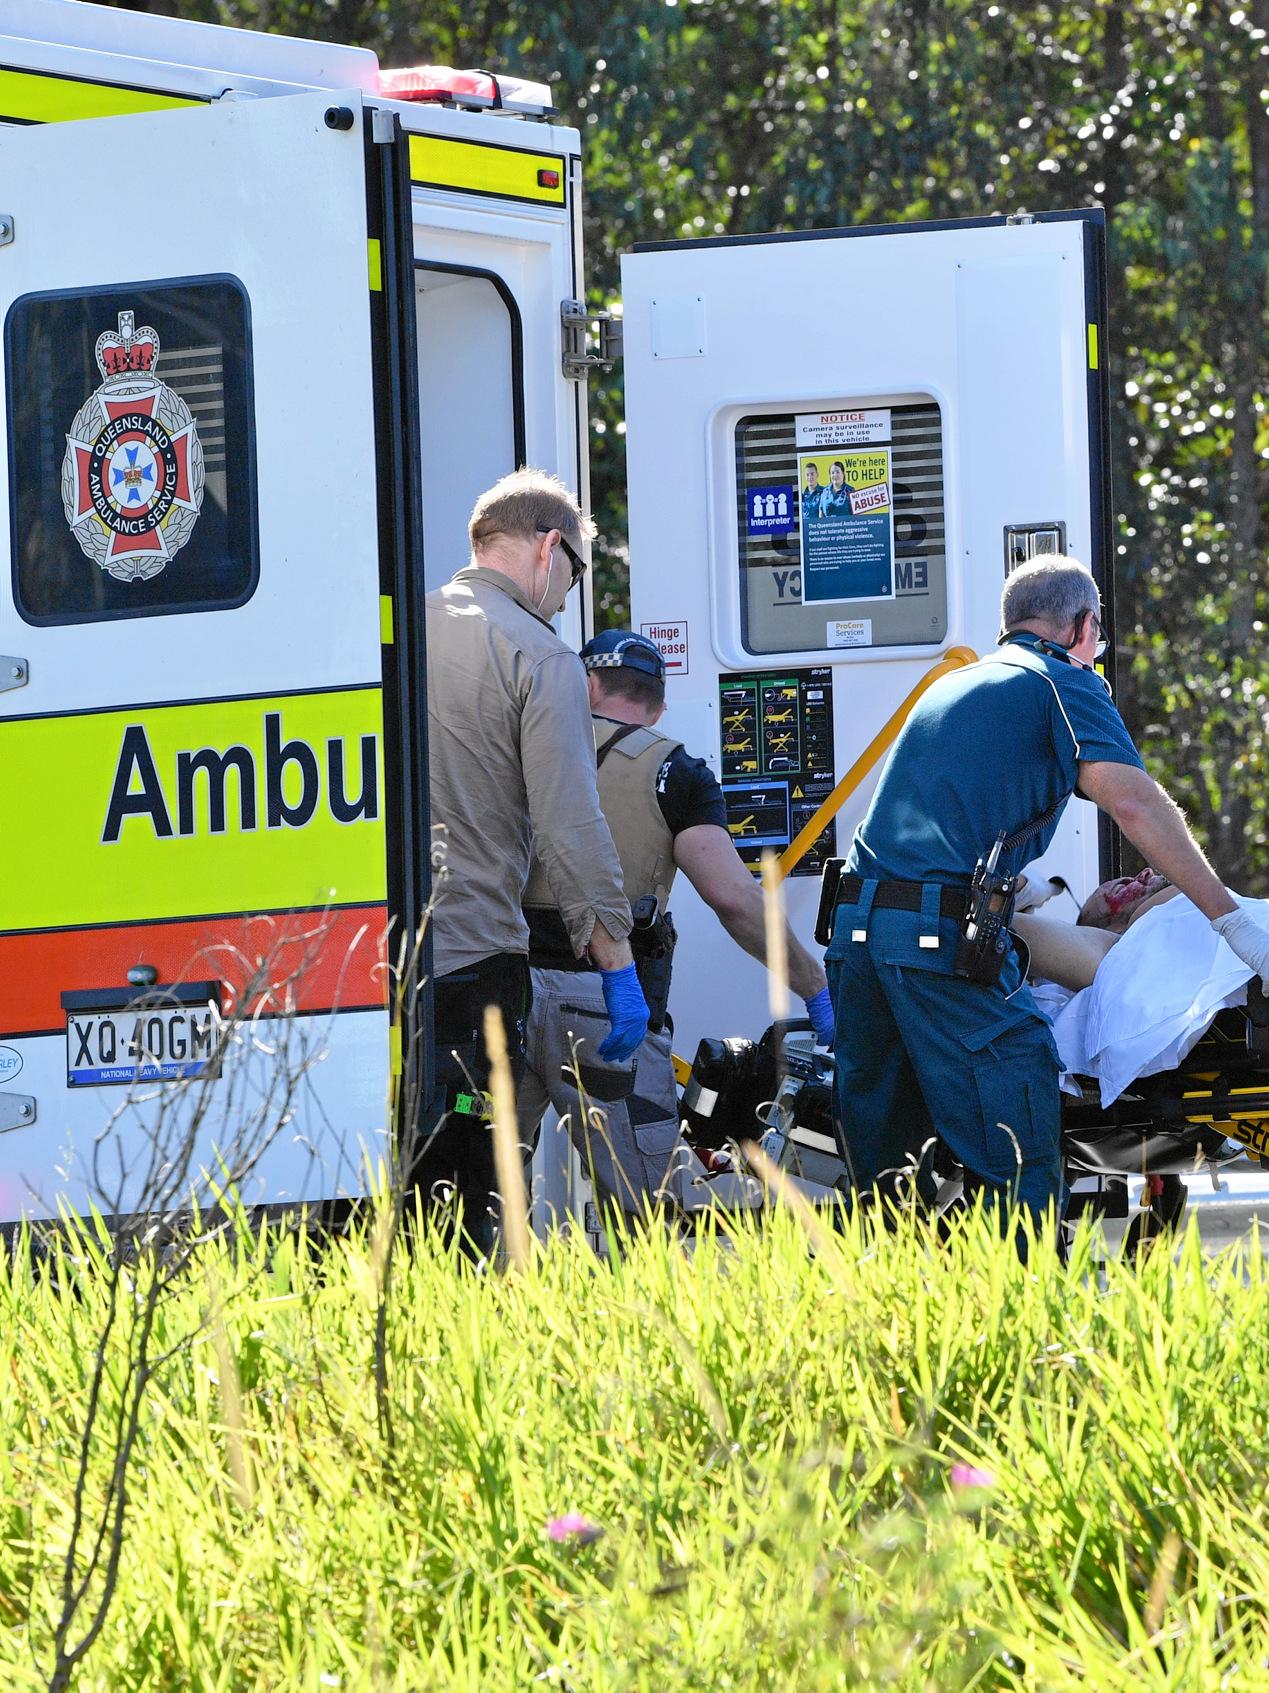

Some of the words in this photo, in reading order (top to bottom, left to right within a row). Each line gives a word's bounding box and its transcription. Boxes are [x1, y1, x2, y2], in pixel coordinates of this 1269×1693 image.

[820, 413, 865, 423] NOTICE
[835, 422, 884, 430] surveillance
[95, 416, 168, 457] QUEENSLAND
[845, 457, 867, 468] We're
[868, 456, 886, 467] here
[846, 470, 860, 482] TO
[861, 468, 885, 481] HELP
[90, 473, 146, 534] AMBULANCE
[147, 463, 176, 527] SERVICE
[854, 492, 887, 511] ABUSE
[750, 516, 791, 528] Interpreter
[817, 521, 843, 529] Queensland
[649, 626, 680, 641] Hinge
[835, 629, 865, 637] Services
[657, 643, 686, 654] lease
[811, 668, 831, 676] stryker
[101, 712, 379, 843] Ambu
[813, 772, 833, 780] stryker
[101, 1069, 134, 1079] NATIONAL
